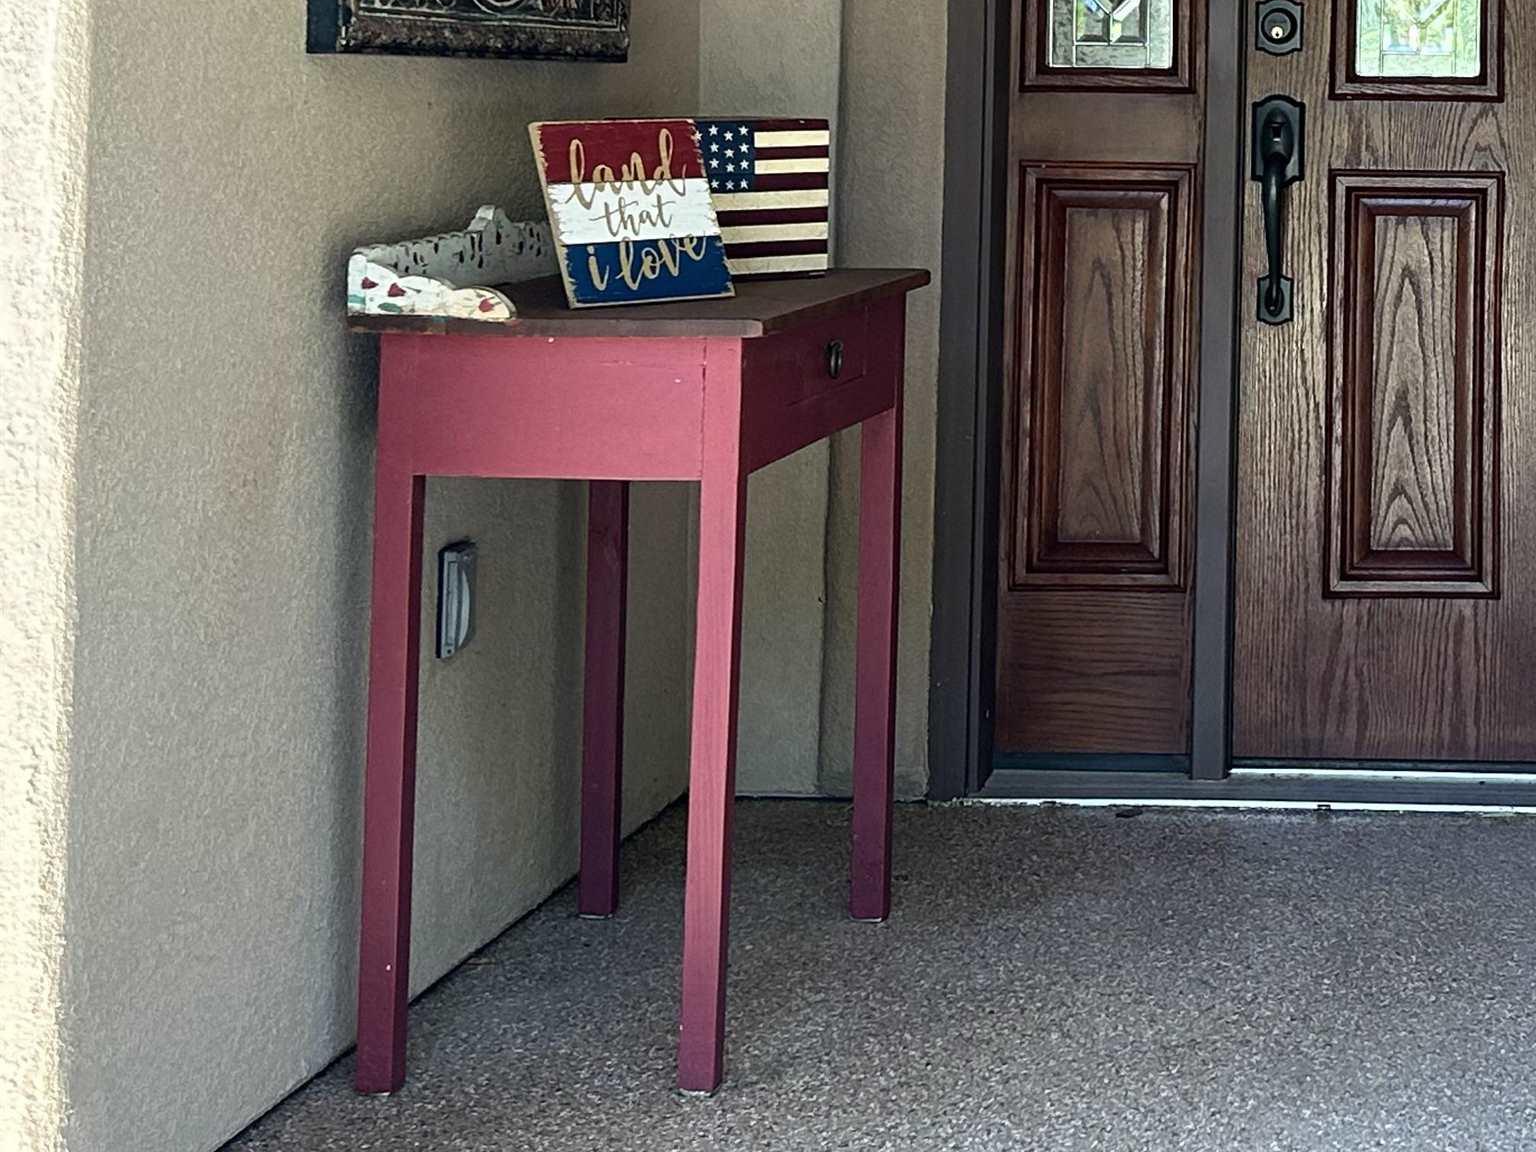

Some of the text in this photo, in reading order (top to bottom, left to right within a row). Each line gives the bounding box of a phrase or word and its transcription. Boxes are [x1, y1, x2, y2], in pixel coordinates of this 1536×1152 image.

[565, 128, 687, 210] land
[589, 194, 676, 236] that
[587, 232, 706, 290] i love
